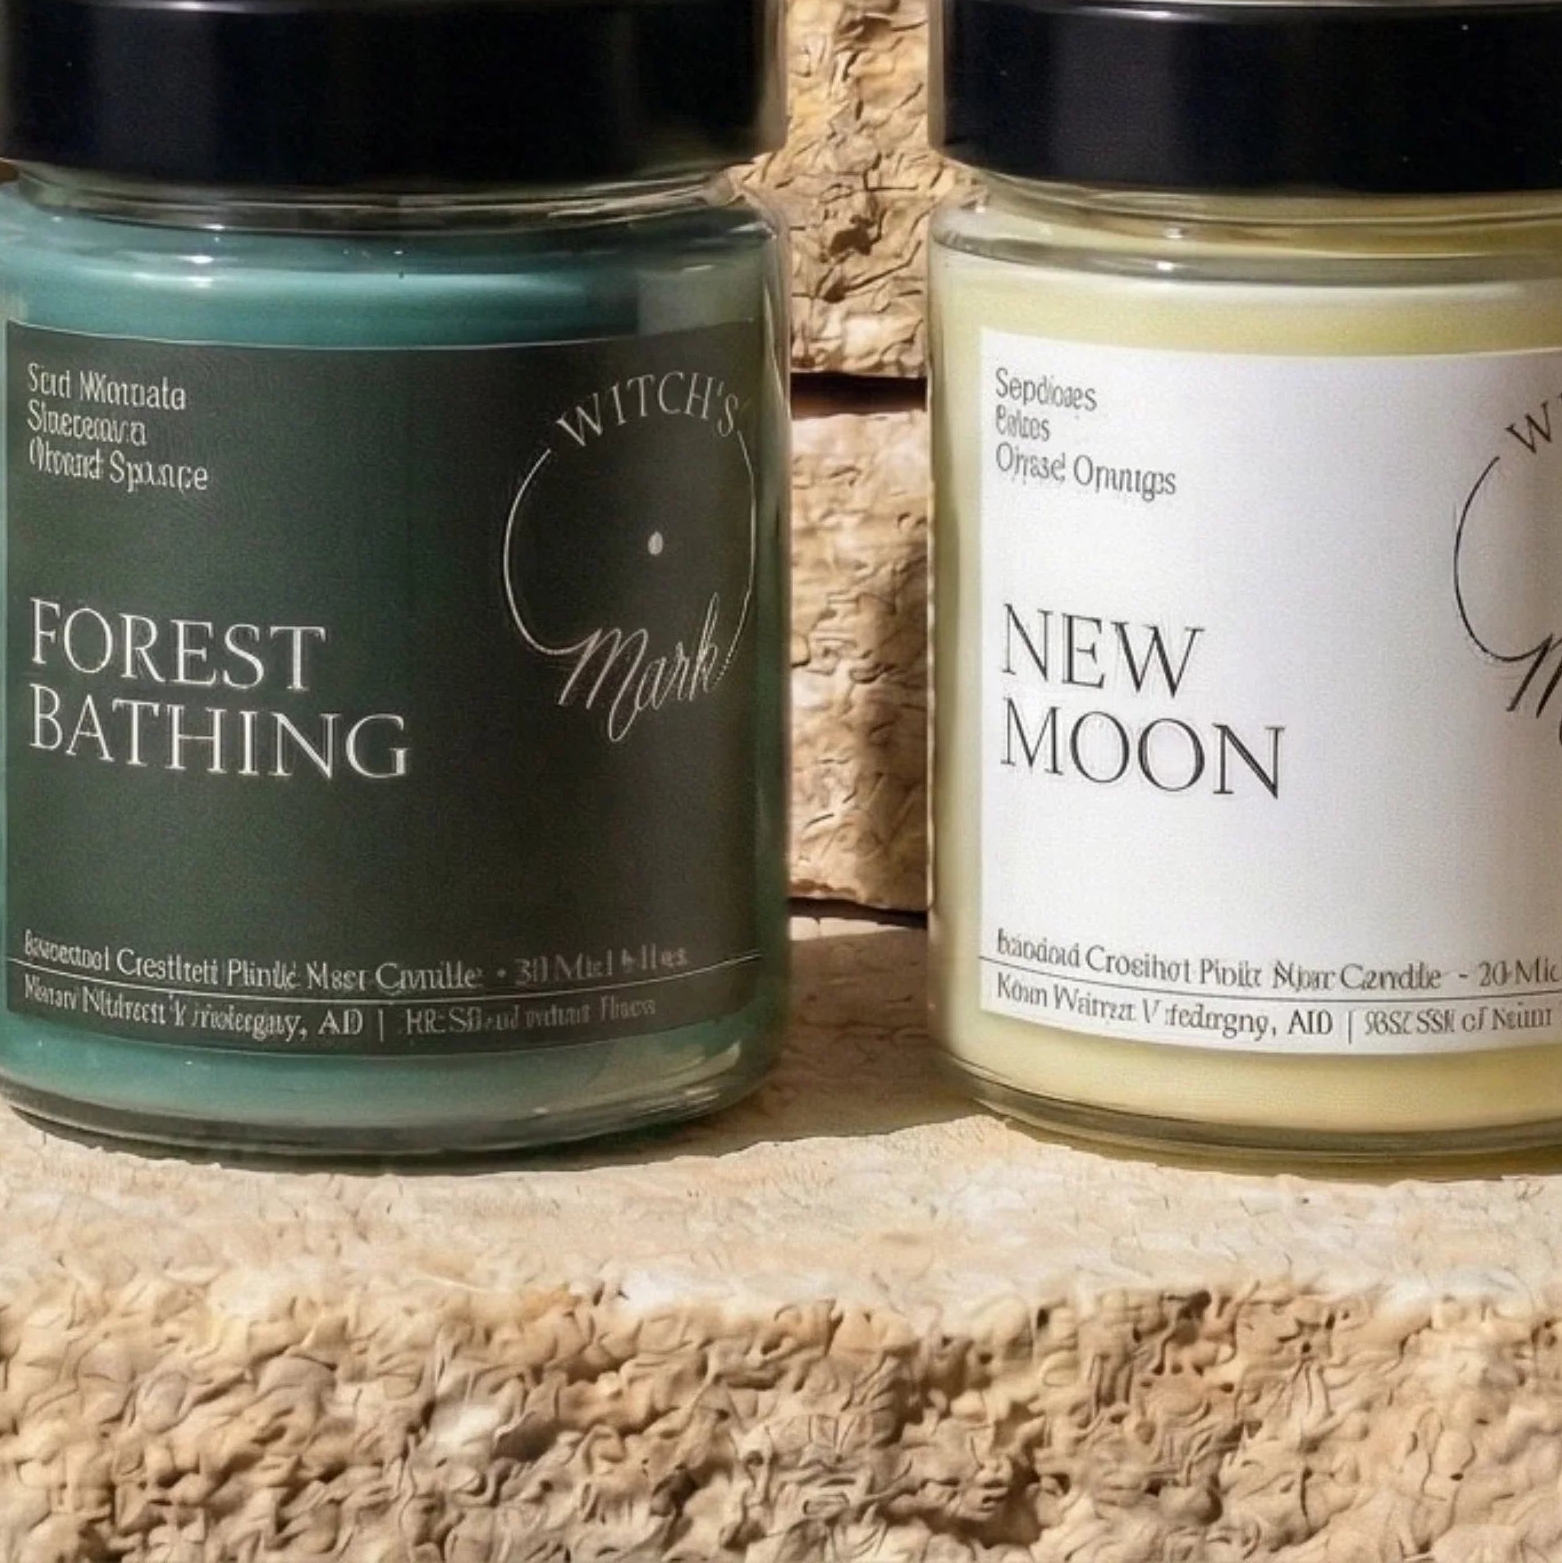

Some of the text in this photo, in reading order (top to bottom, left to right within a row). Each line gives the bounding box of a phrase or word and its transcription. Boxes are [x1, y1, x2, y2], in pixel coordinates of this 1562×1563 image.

[556, 371, 739, 446] WITCH'S
[29, 598, 327, 692] FOREST
[558, 592, 720, 742] Mark
[1001, 603, 1205, 698] NEW
[29, 684, 412, 780] BATHING
[1000, 697, 1286, 800] MOON
